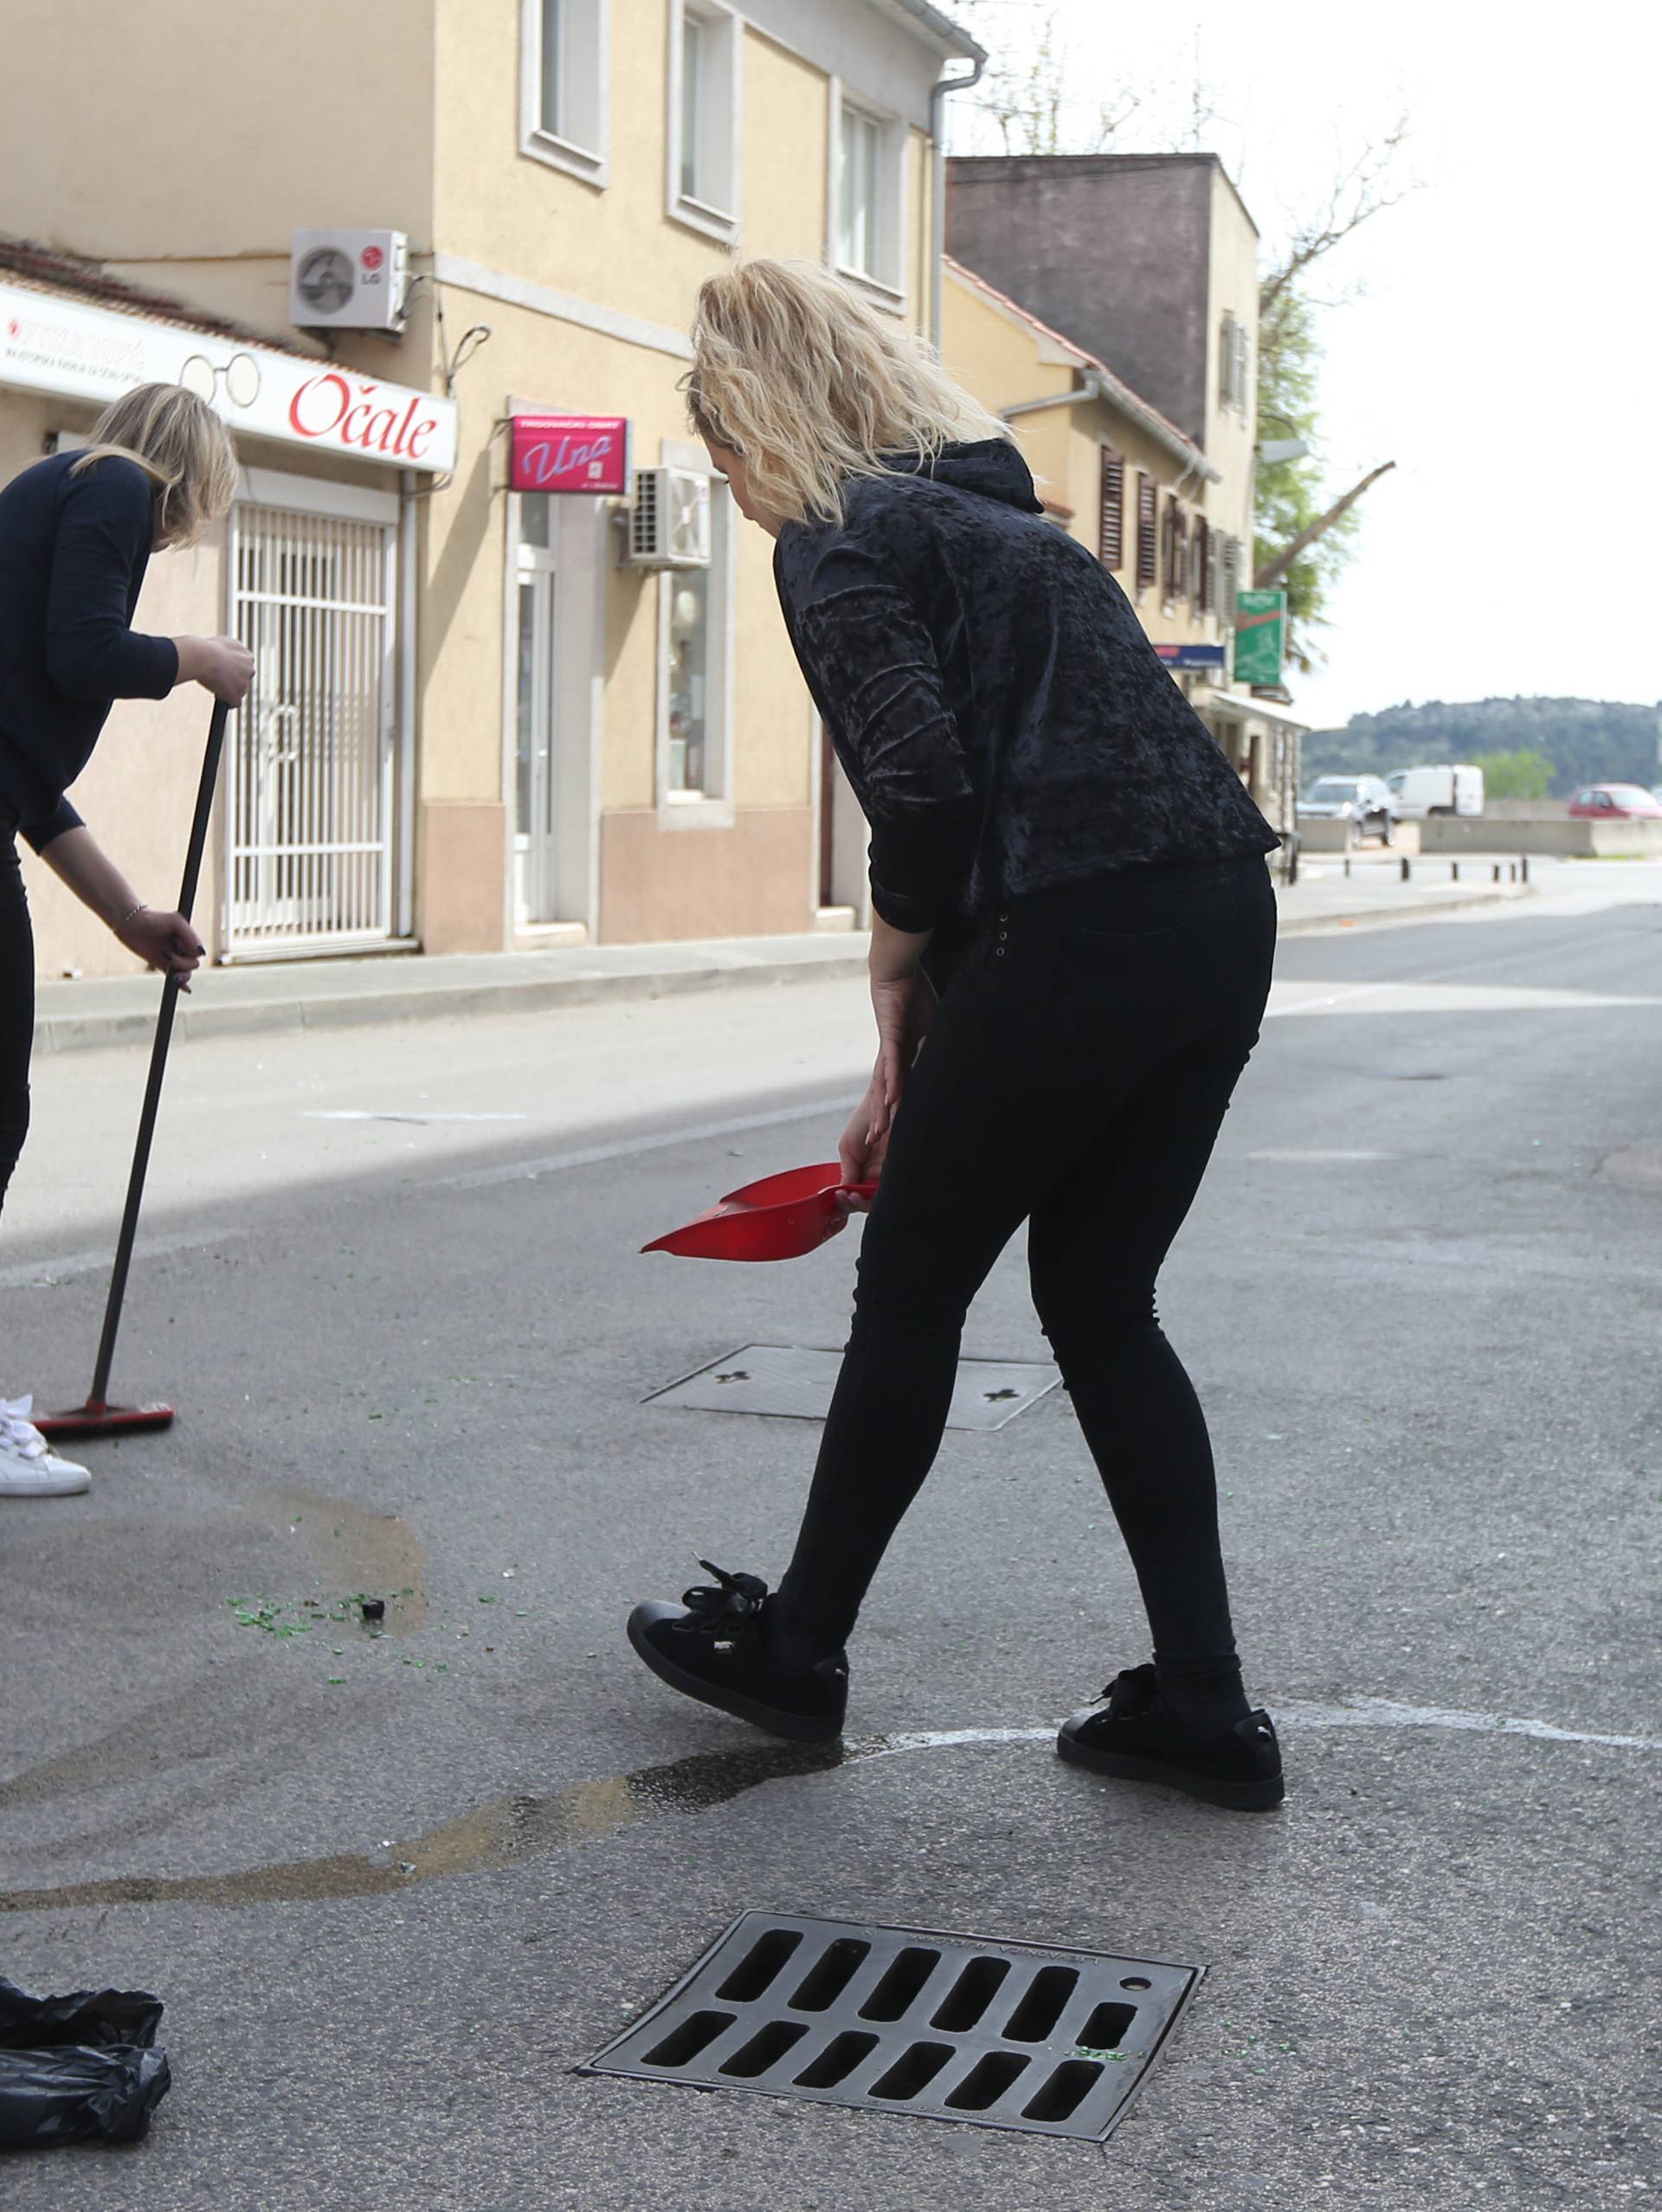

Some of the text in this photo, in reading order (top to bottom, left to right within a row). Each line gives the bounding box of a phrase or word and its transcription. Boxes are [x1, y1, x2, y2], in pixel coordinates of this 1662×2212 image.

[362, 274, 381, 285] LG
[288, 374, 437, 459] Očale
[522, 435, 612, 485] Una
